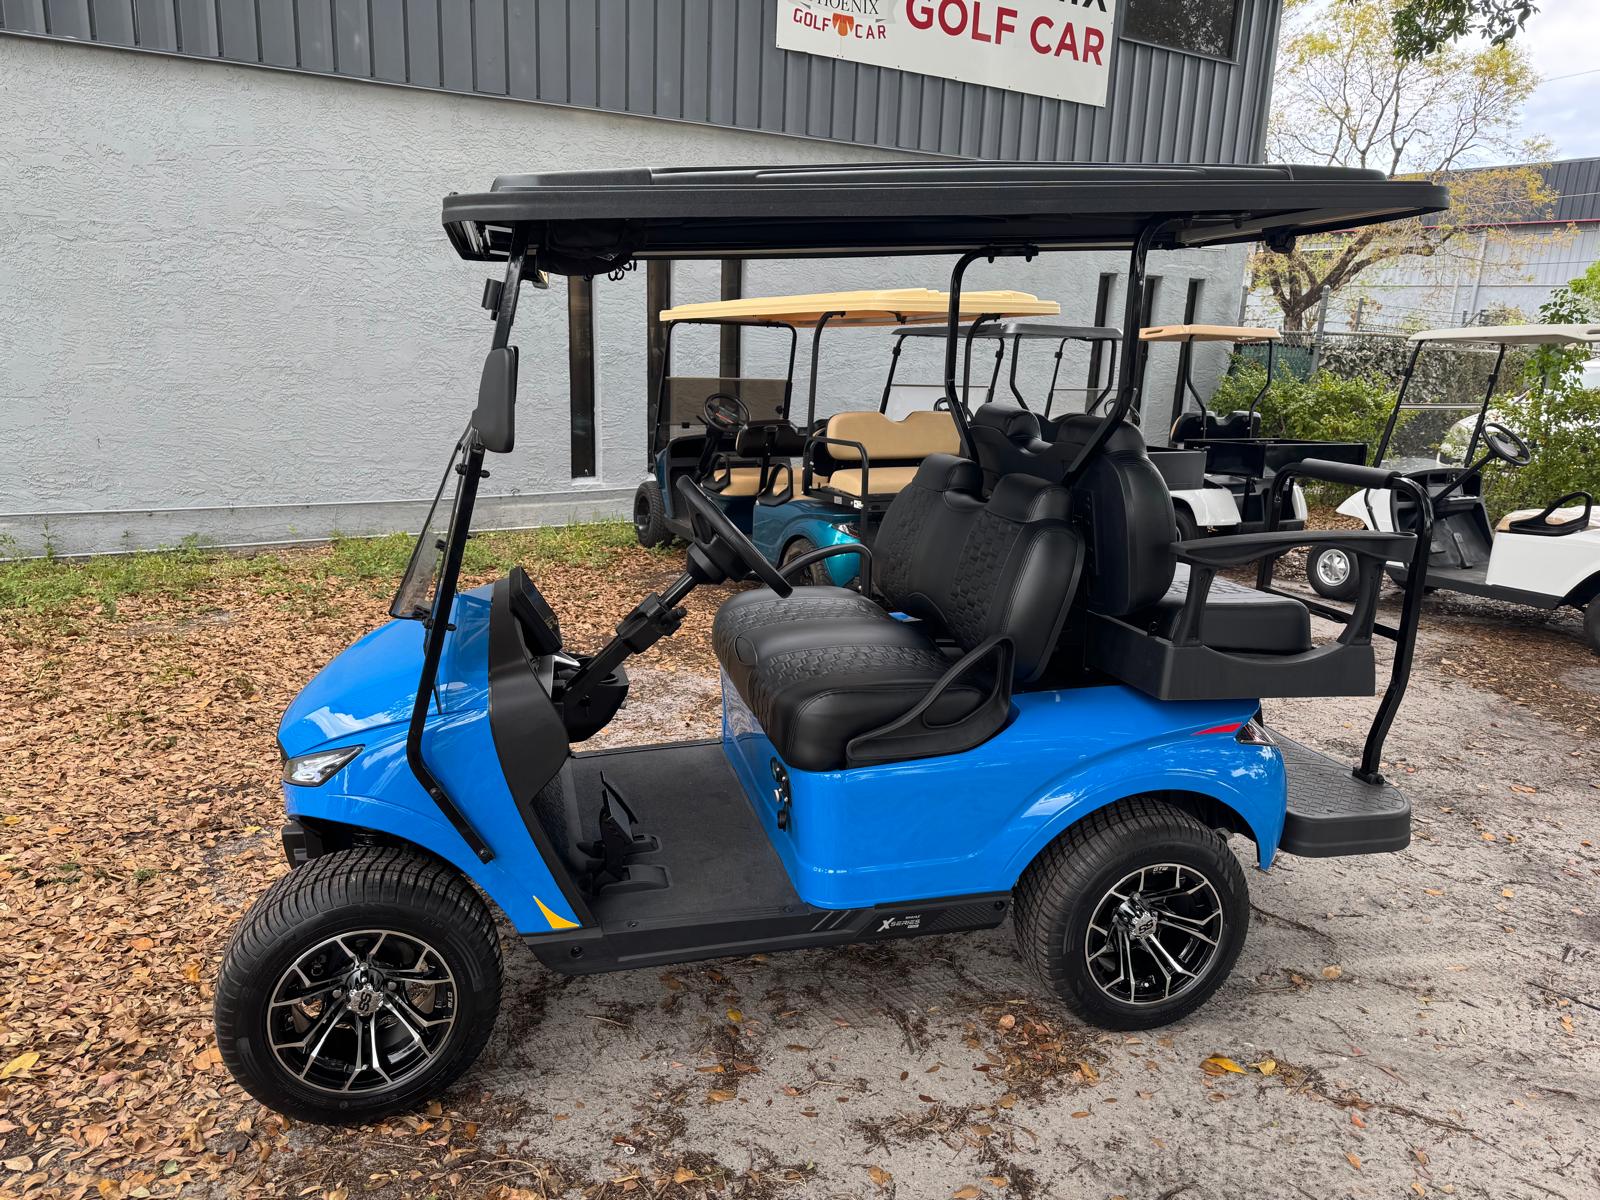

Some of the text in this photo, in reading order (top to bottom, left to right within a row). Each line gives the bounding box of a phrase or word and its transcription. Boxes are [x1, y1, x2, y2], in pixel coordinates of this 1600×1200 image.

[793, 8, 887, 40] GOLF CAR
[905, 0, 1105, 66] GOLF CAR
